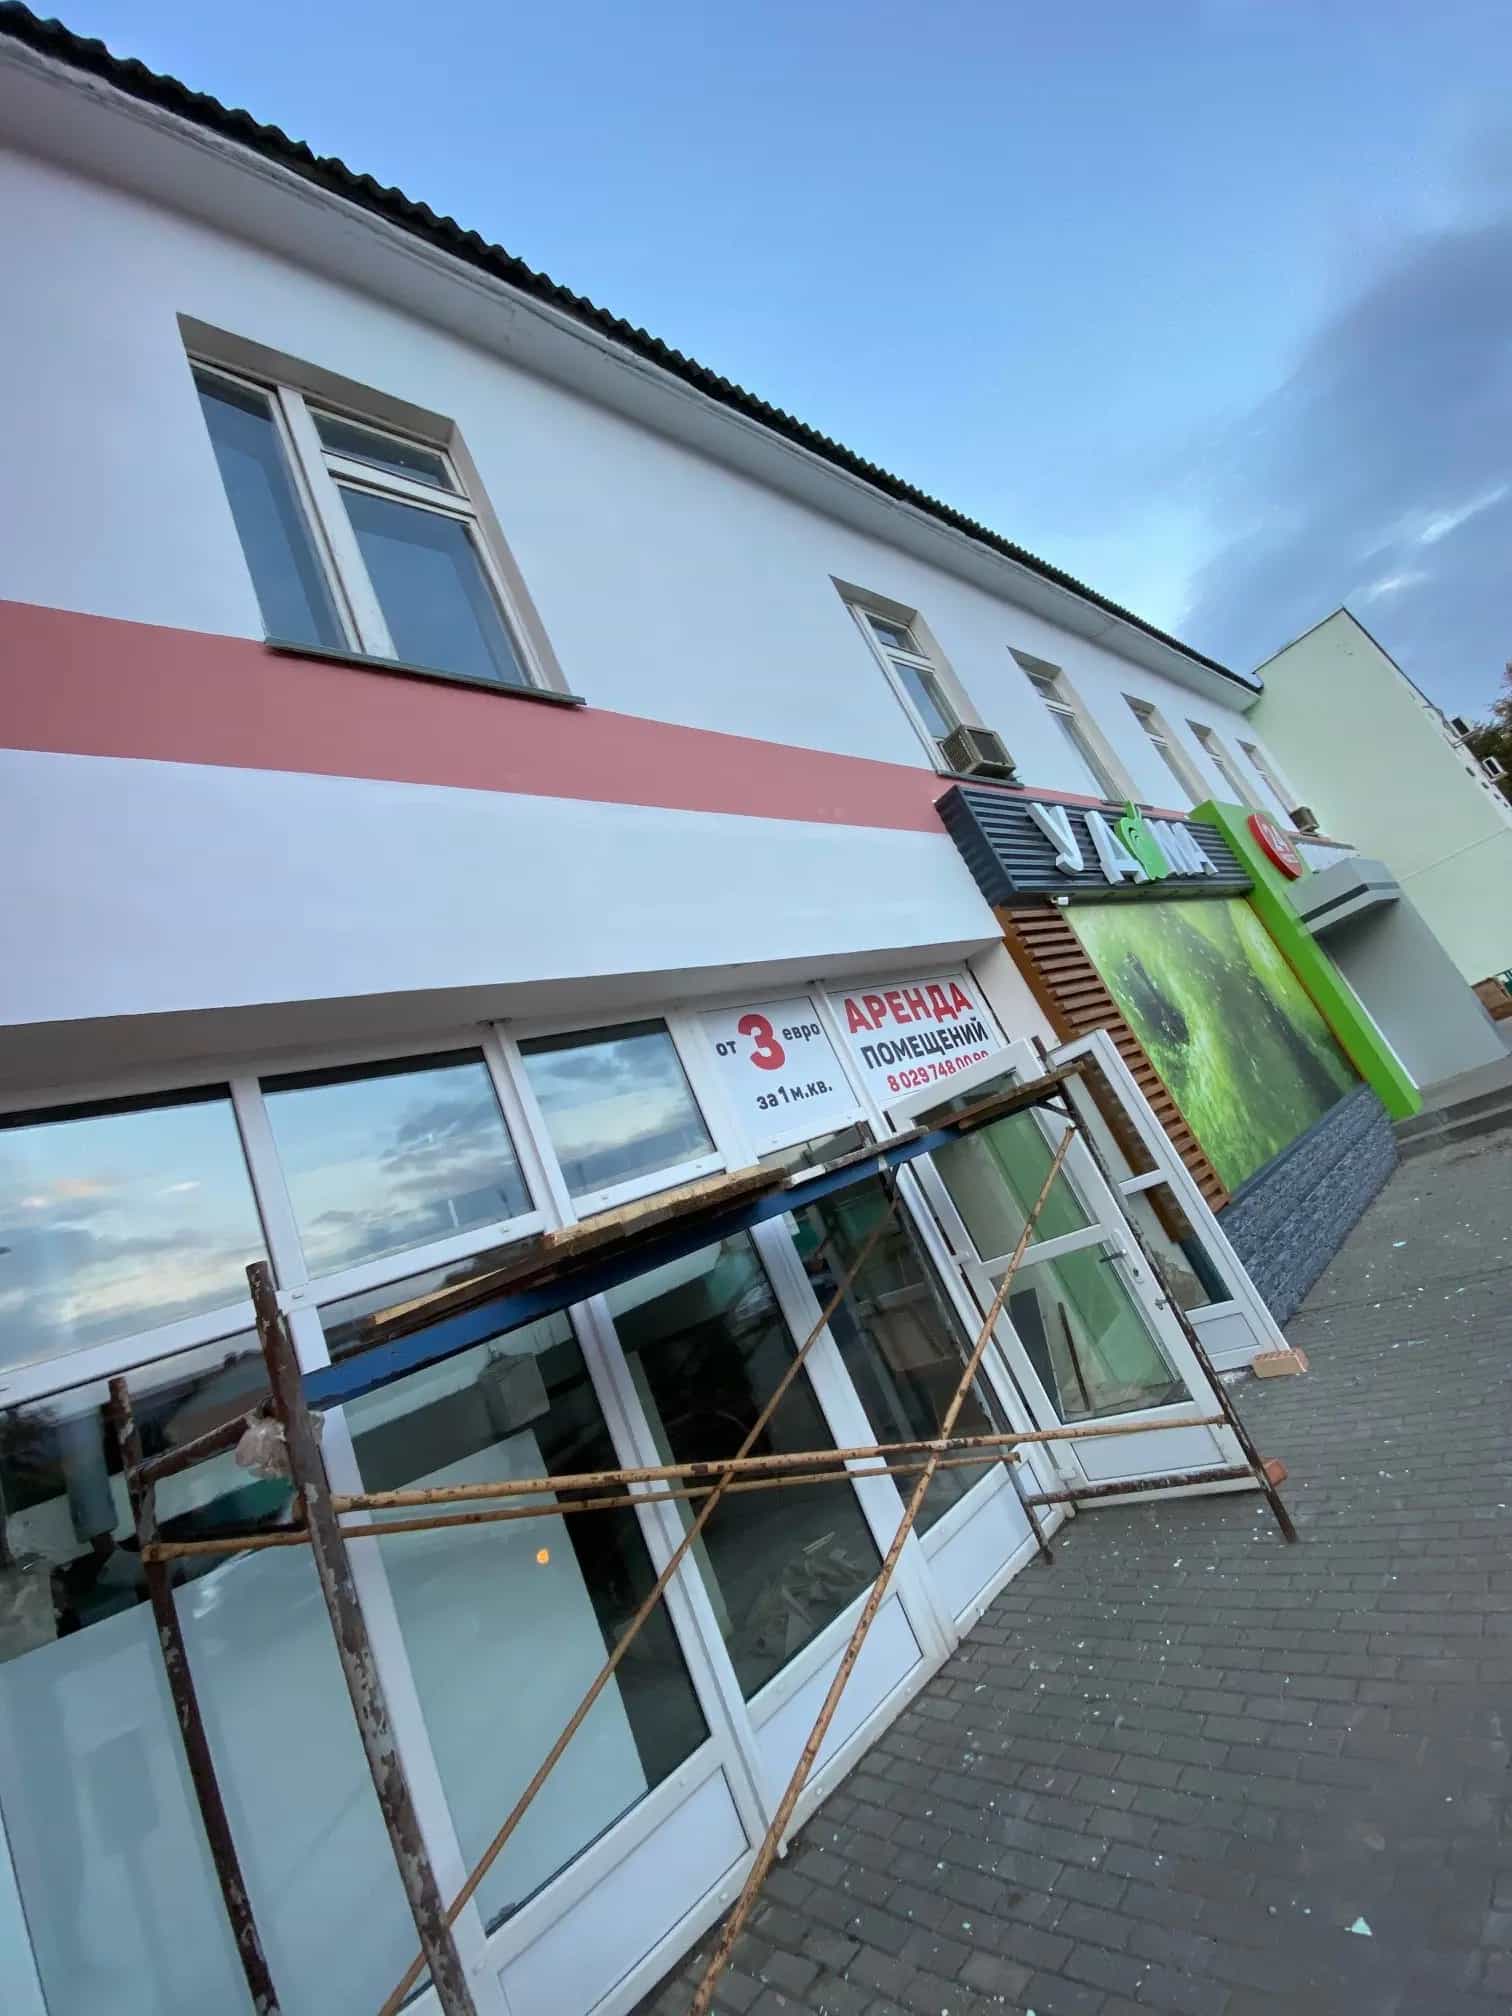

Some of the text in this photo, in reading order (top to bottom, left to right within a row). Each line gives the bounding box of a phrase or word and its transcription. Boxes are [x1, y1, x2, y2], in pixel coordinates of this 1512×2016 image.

[843, 982, 974, 1035] АРЕНДА
[715, 1013, 821, 1071] от 3 евро
[860, 1016, 989, 1069] ПОМЕЩЕНИЙ
[756, 1080, 833, 1110] за 1 м.кв.
[887, 1074, 900, 1092] 8
[899, 1066, 930, 1089] 029
[928, 1060, 956, 1080] 748
